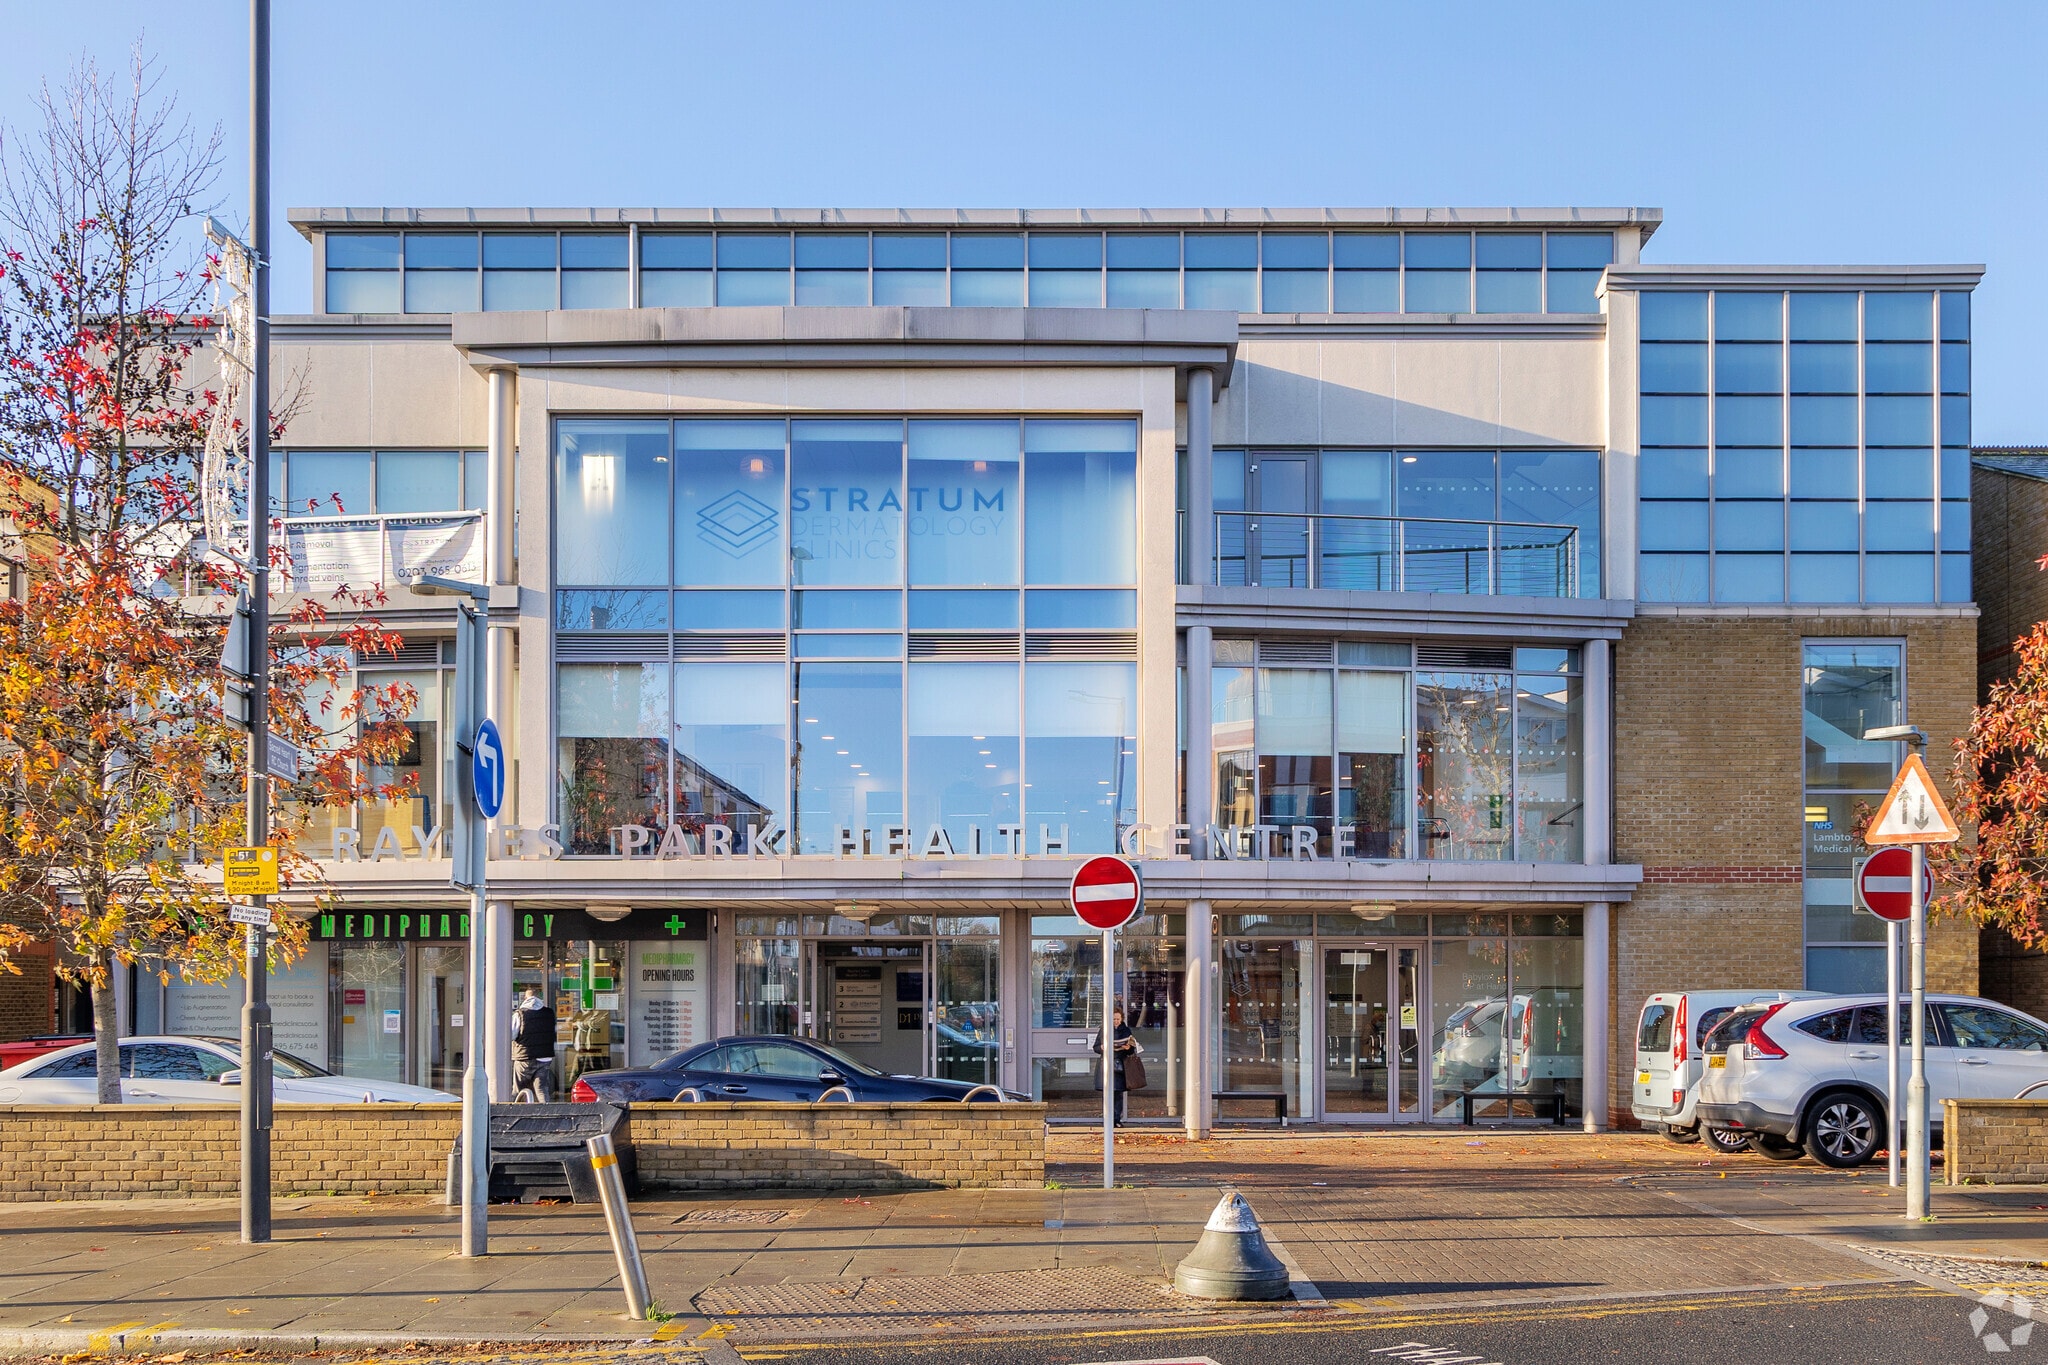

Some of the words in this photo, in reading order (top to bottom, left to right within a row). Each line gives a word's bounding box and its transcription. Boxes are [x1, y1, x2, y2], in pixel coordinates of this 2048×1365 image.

[791, 487, 1005, 512] STRATUM
[791, 516, 1005, 537] DERMATOLOGY
[791, 539, 897, 560] CLINICS
[397, 567, 428, 579] 0203
[430, 565, 451, 576] 965
[1813, 822, 1833, 830] NHS
[332, 824, 566, 862] RAYES
[621, 824, 779, 861] PARK
[832, 823, 1070, 861] HEALTH
[1121, 824, 1357, 862] CENTRE
[1813, 833, 1853, 842] Lambto
[1813, 844, 1852, 853] Medical
[240, 914, 252, 922] any
[253, 914, 268, 923] time
[245, 908, 268, 918] loading
[320, 914, 555, 938] MEDIPHARCY
[642, 952, 695, 965] MEDIPHARMACY
[642, 969, 671, 982] OPENING
[672, 969, 695, 982] HOURS
